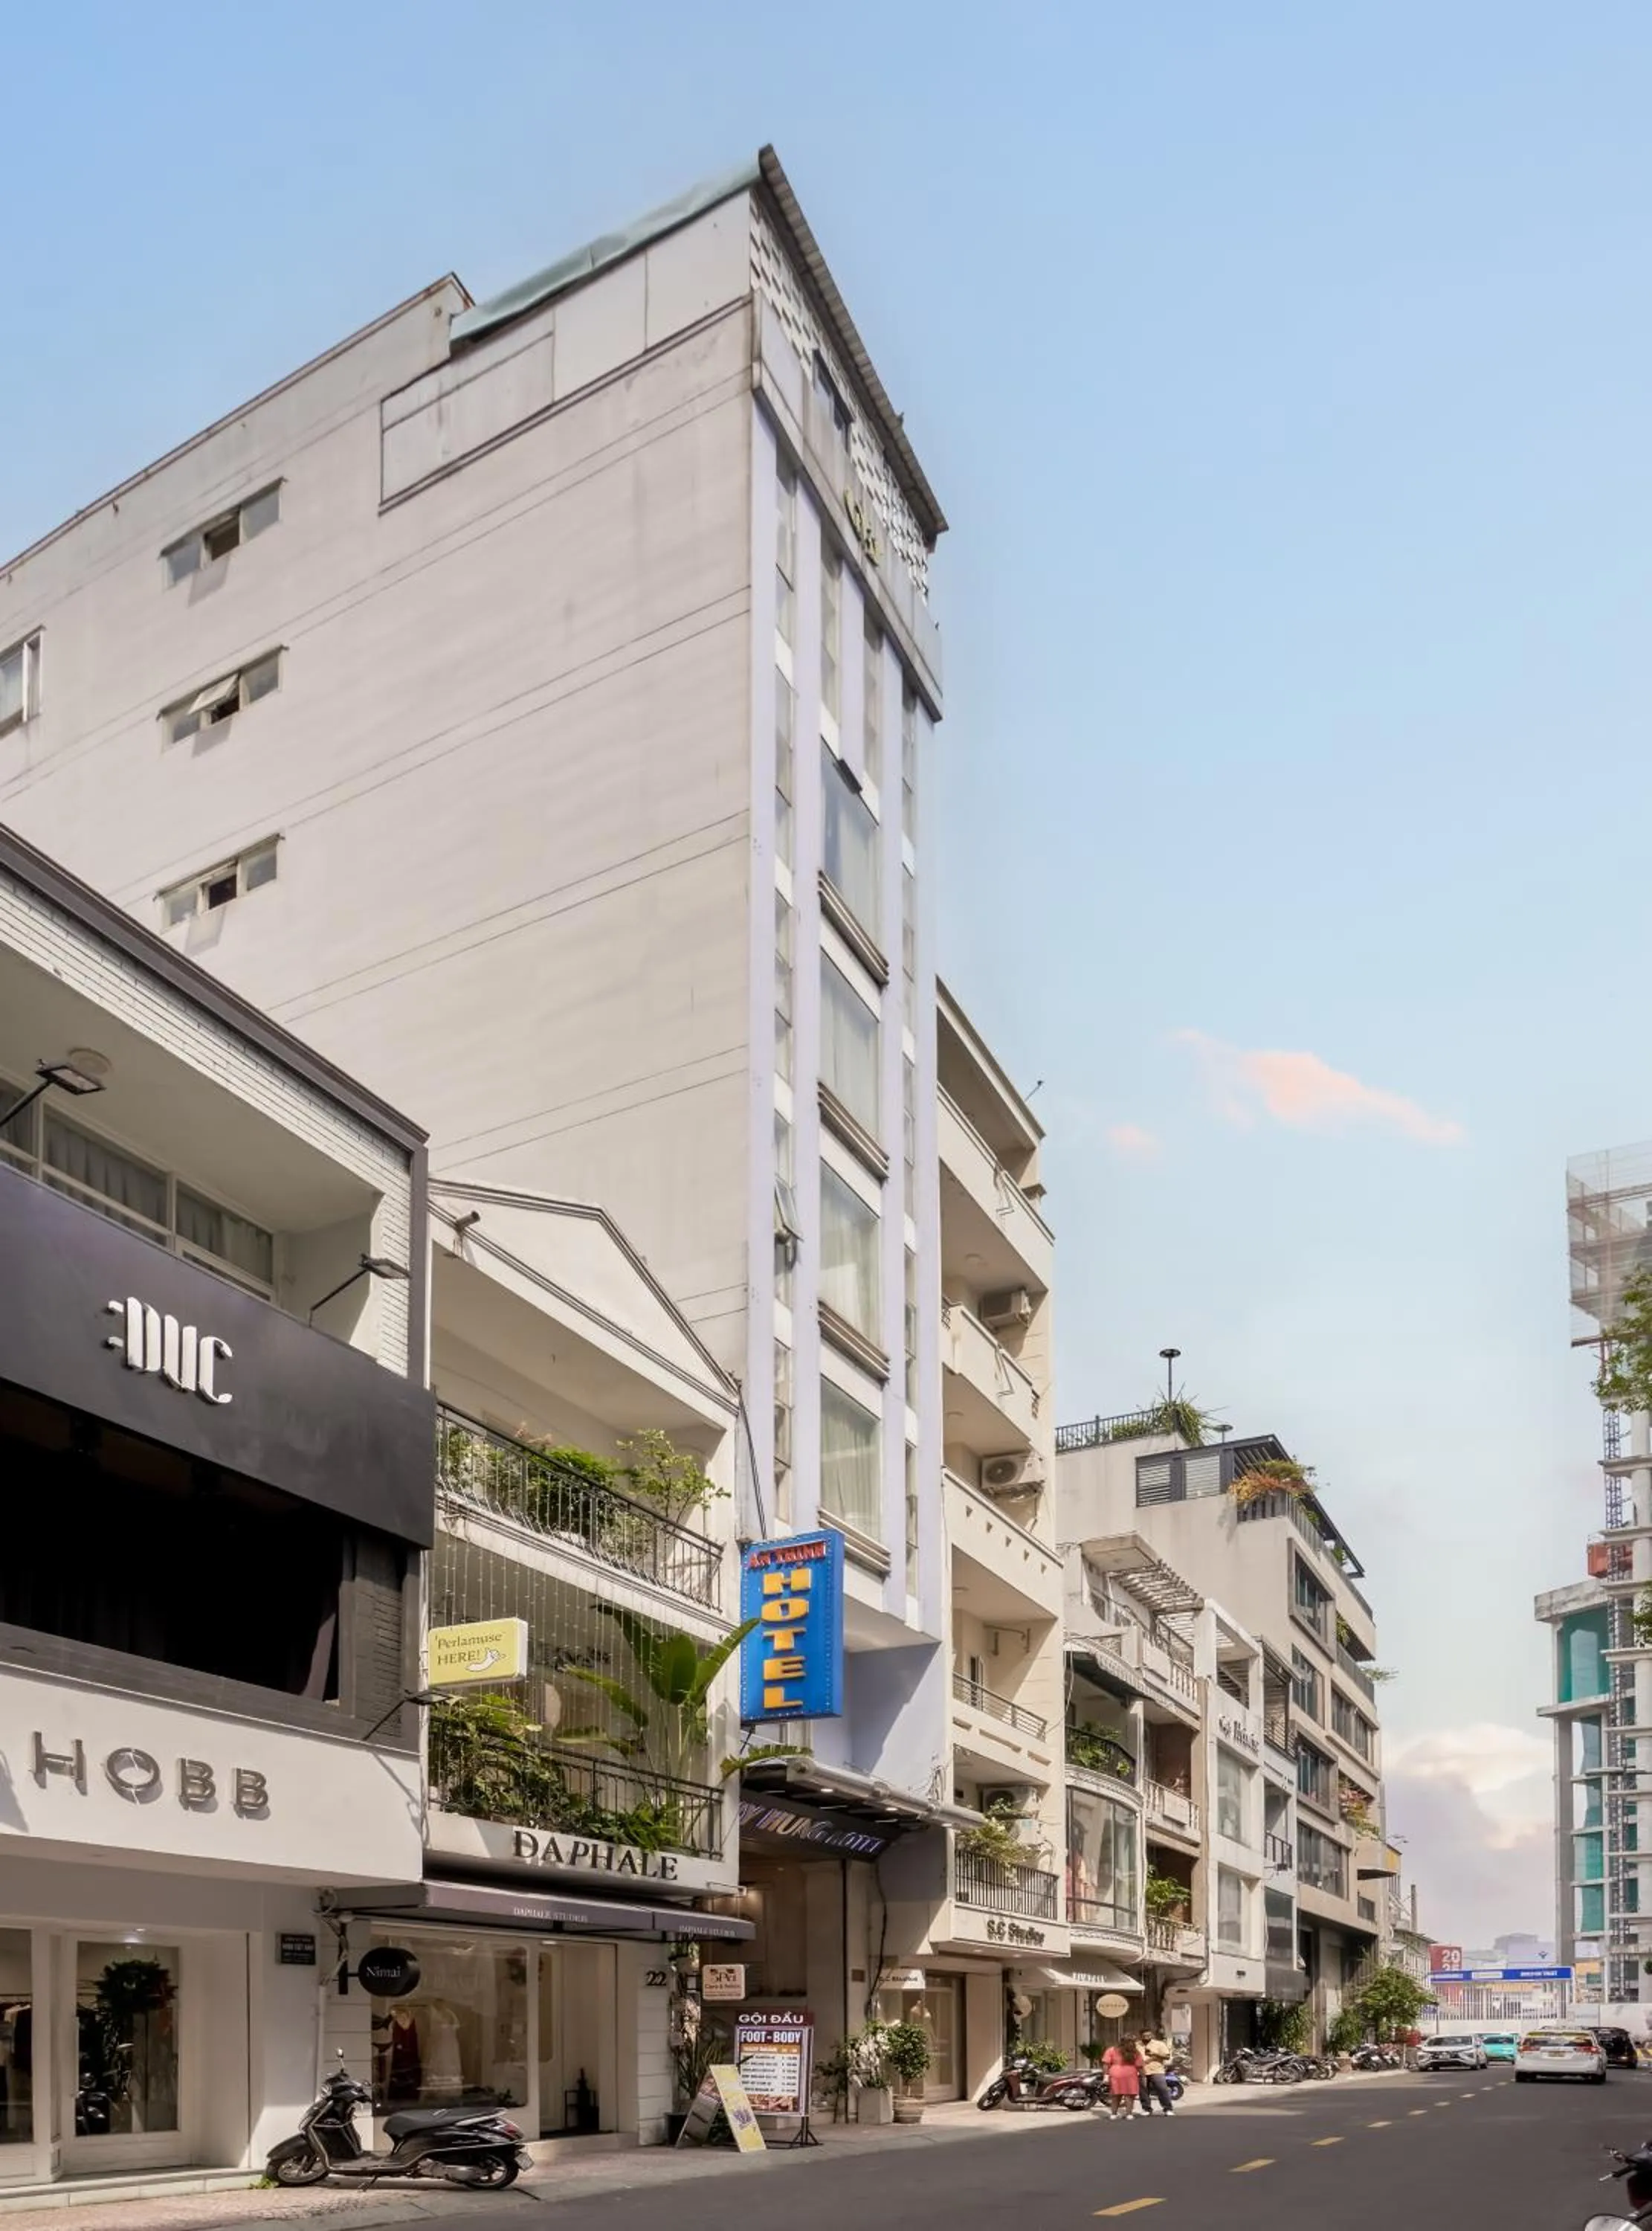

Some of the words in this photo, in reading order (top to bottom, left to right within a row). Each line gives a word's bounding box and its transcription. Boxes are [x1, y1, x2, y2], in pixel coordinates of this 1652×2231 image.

[761, 1568, 812, 1708] HOTEL
[438, 1649, 480, 1665] HERE!
[33, 1731, 269, 1812] HOBB
[514, 1830, 678, 1881] DAPHALE
[1442, 1949, 1460, 1963] 20
[645, 1970, 667, 1986] 22
[738, 2012, 767, 2025] GỘI
